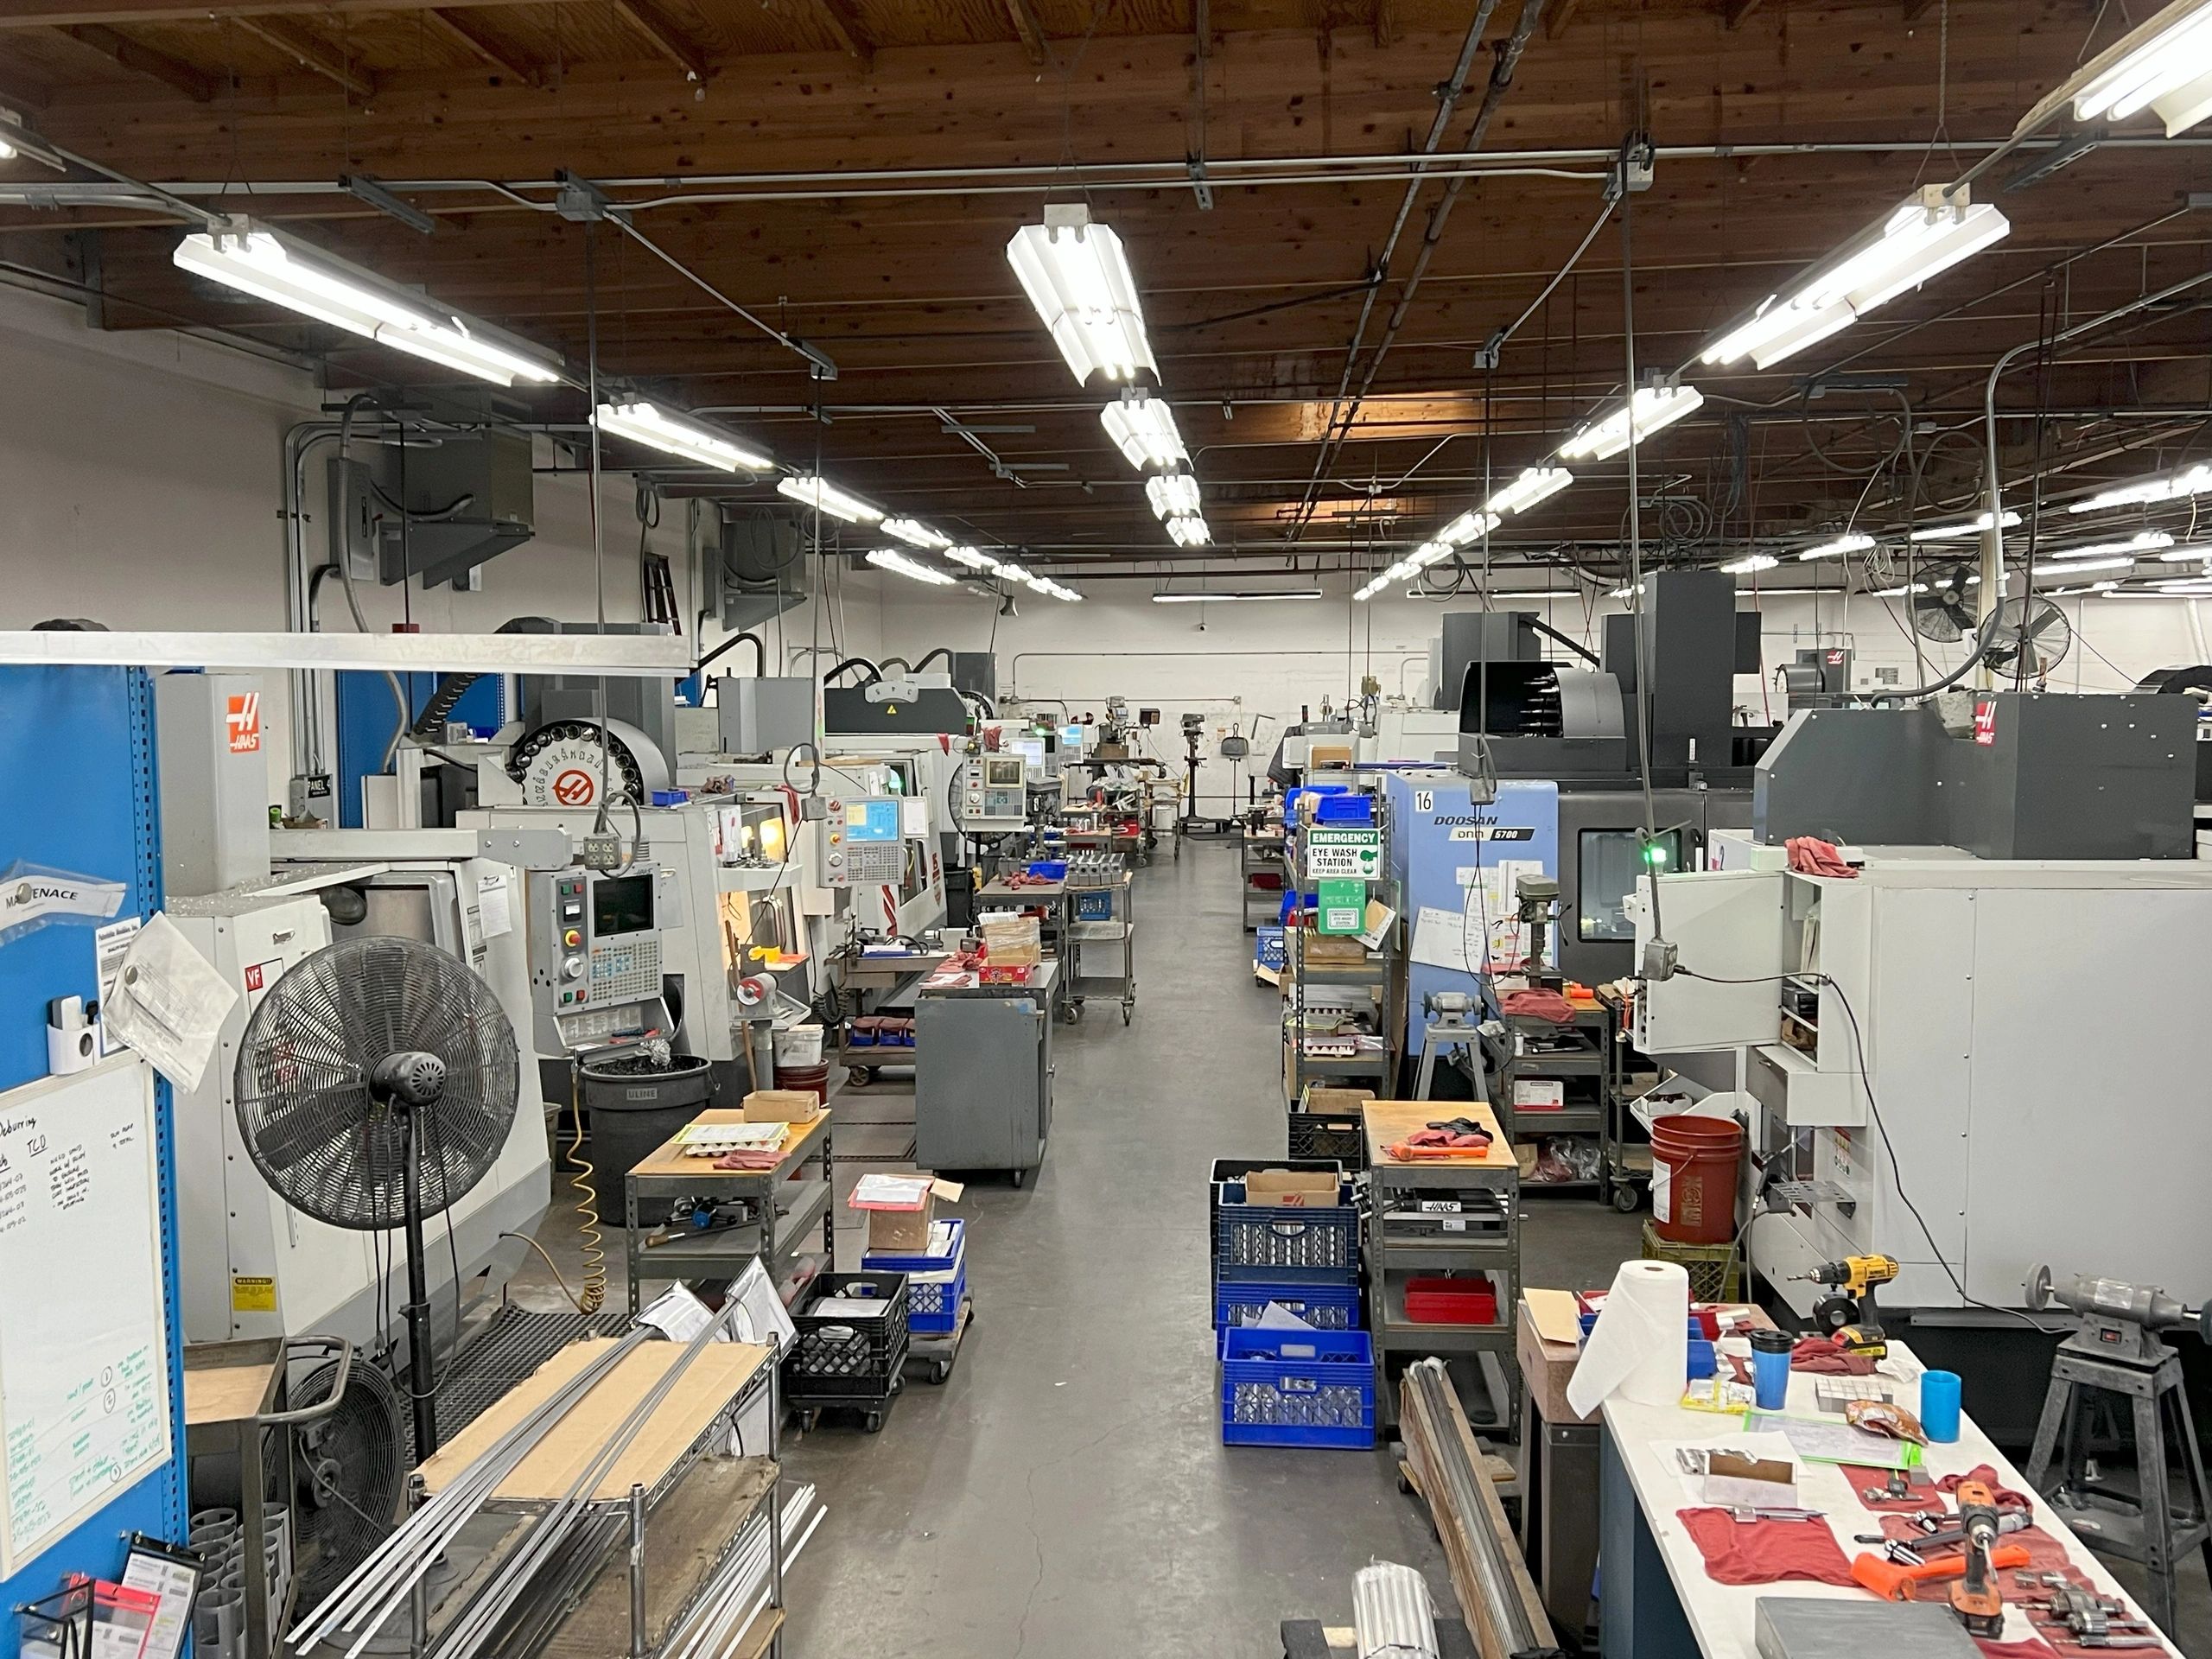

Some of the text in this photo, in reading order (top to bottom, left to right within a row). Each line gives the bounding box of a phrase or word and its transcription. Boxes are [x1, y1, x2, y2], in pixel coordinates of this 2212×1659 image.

[229, 733, 259, 750] HAAS
[1416, 791, 1432, 810] 16
[1434, 816, 1498, 825] DOOSAN
[1313, 832, 1376, 843] EMERGENCY
[1494, 830, 1519, 839] 5700
[1313, 849, 1357, 857] EYE WASH
[1317, 858, 1353, 867] STATION
[5, 888, 79, 909] MAENACE
[246, 968, 260, 987] VF
[627, 1090, 656, 1098] ULINE
[1426, 1202, 1459, 1211] HAAS
